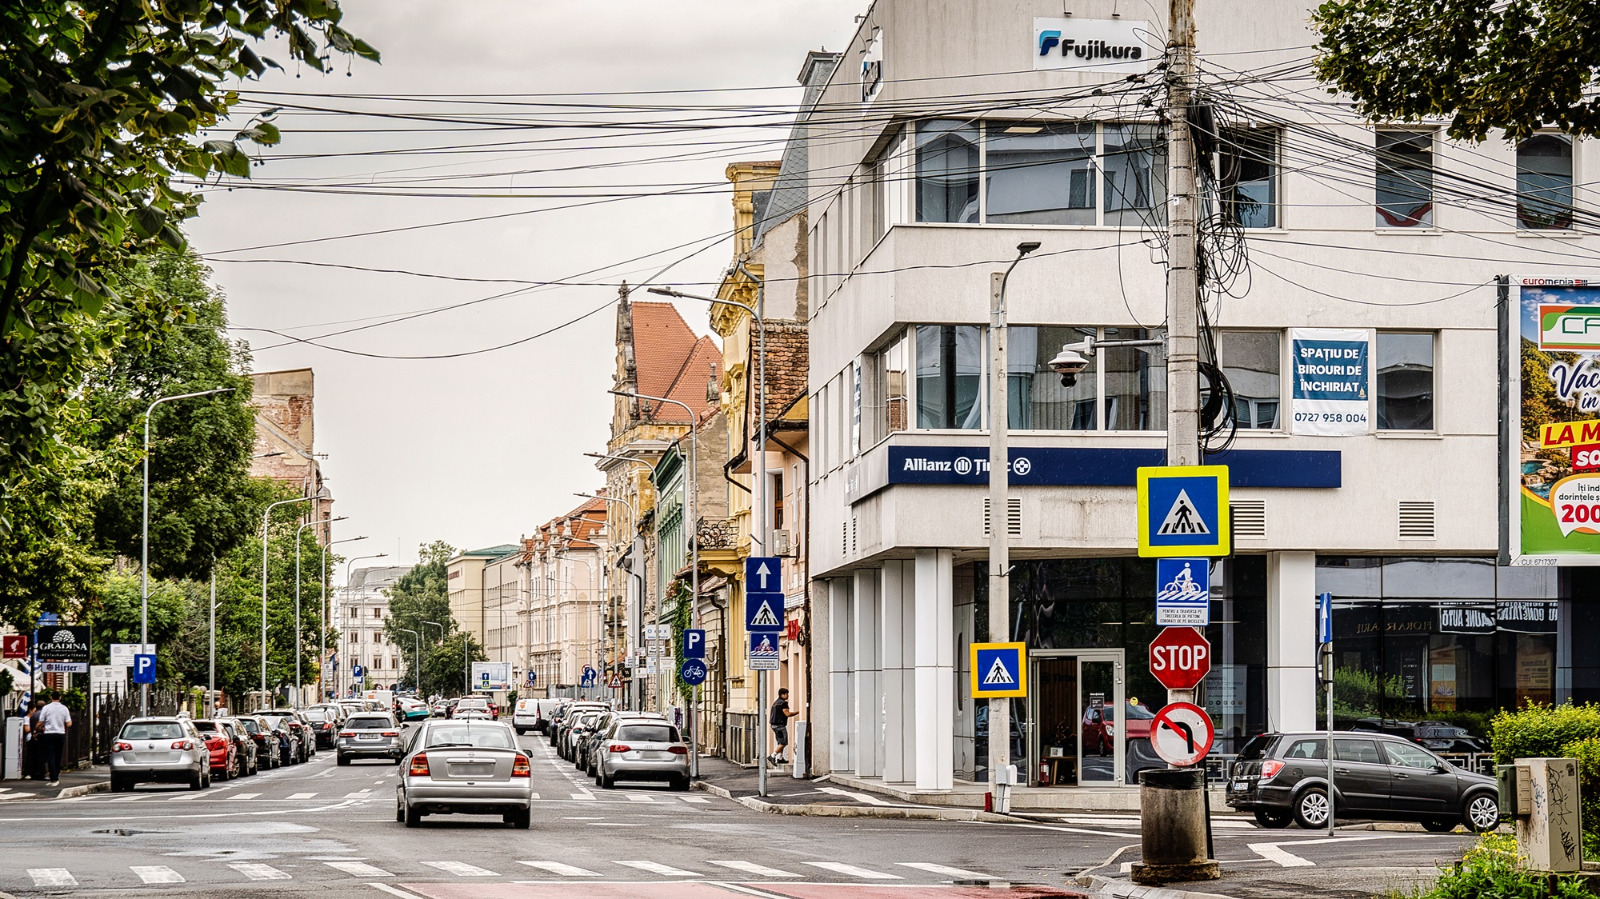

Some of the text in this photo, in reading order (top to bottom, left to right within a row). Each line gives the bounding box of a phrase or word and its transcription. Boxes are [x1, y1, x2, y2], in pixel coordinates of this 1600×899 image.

[1061, 39, 1142, 60] Fujikura
[1344, 349, 1359, 359] DE
[1298, 365, 1362, 375] BIROURI DE
[1300, 379, 1360, 392] ÎNCHIRIAT
[1582, 392, 1599, 409] în
[1295, 413, 1367, 422] 0727 958 004
[1544, 425, 1575, 446] LA
[903, 458, 952, 471] Allianz
[1558, 493, 1595, 503] dorințele
[688, 632, 701, 650] P
[1153, 645, 1207, 671] STOP
[54, 664, 78, 672] Hirter
[139, 657, 152, 675] P
[355, 666, 361, 674] P
